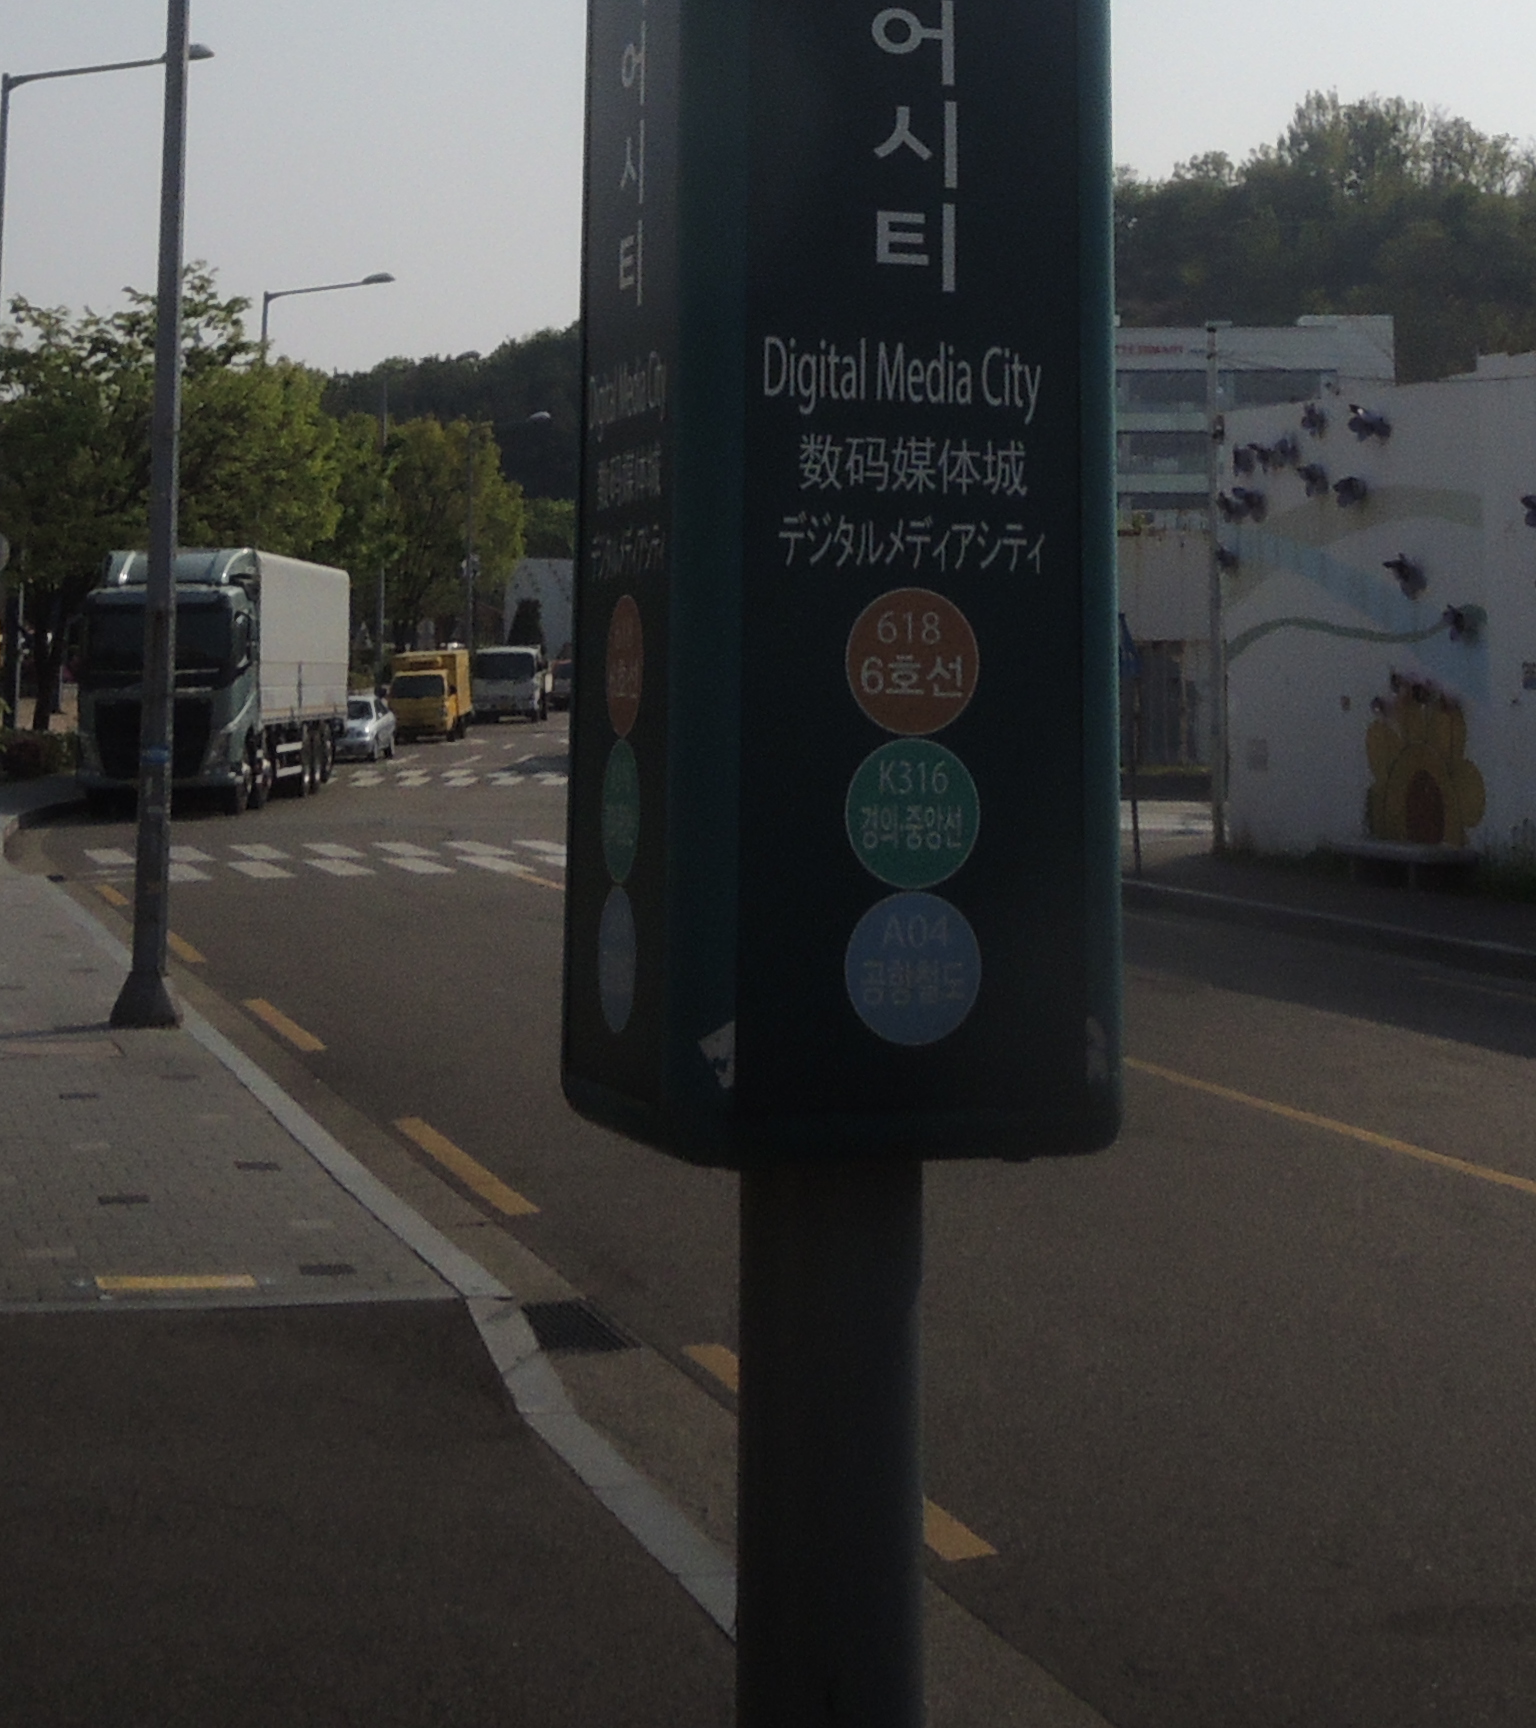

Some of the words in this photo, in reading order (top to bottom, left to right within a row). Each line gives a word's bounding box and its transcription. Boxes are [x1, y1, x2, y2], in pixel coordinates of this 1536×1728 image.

[764, 335, 866, 415] Digital
[876, 341, 973, 405] Media
[981, 346, 1042, 425] City
[799, 433, 1028, 497] 数码媒体城
[778, 510, 1046, 574] デジタルメディアシティ
[877, 610, 942, 645] 618
[860, 653, 964, 698] 6호선
[878, 760, 949, 797] K316
[881, 913, 947, 949] A04
[861, 957, 966, 1007] 공항철도
